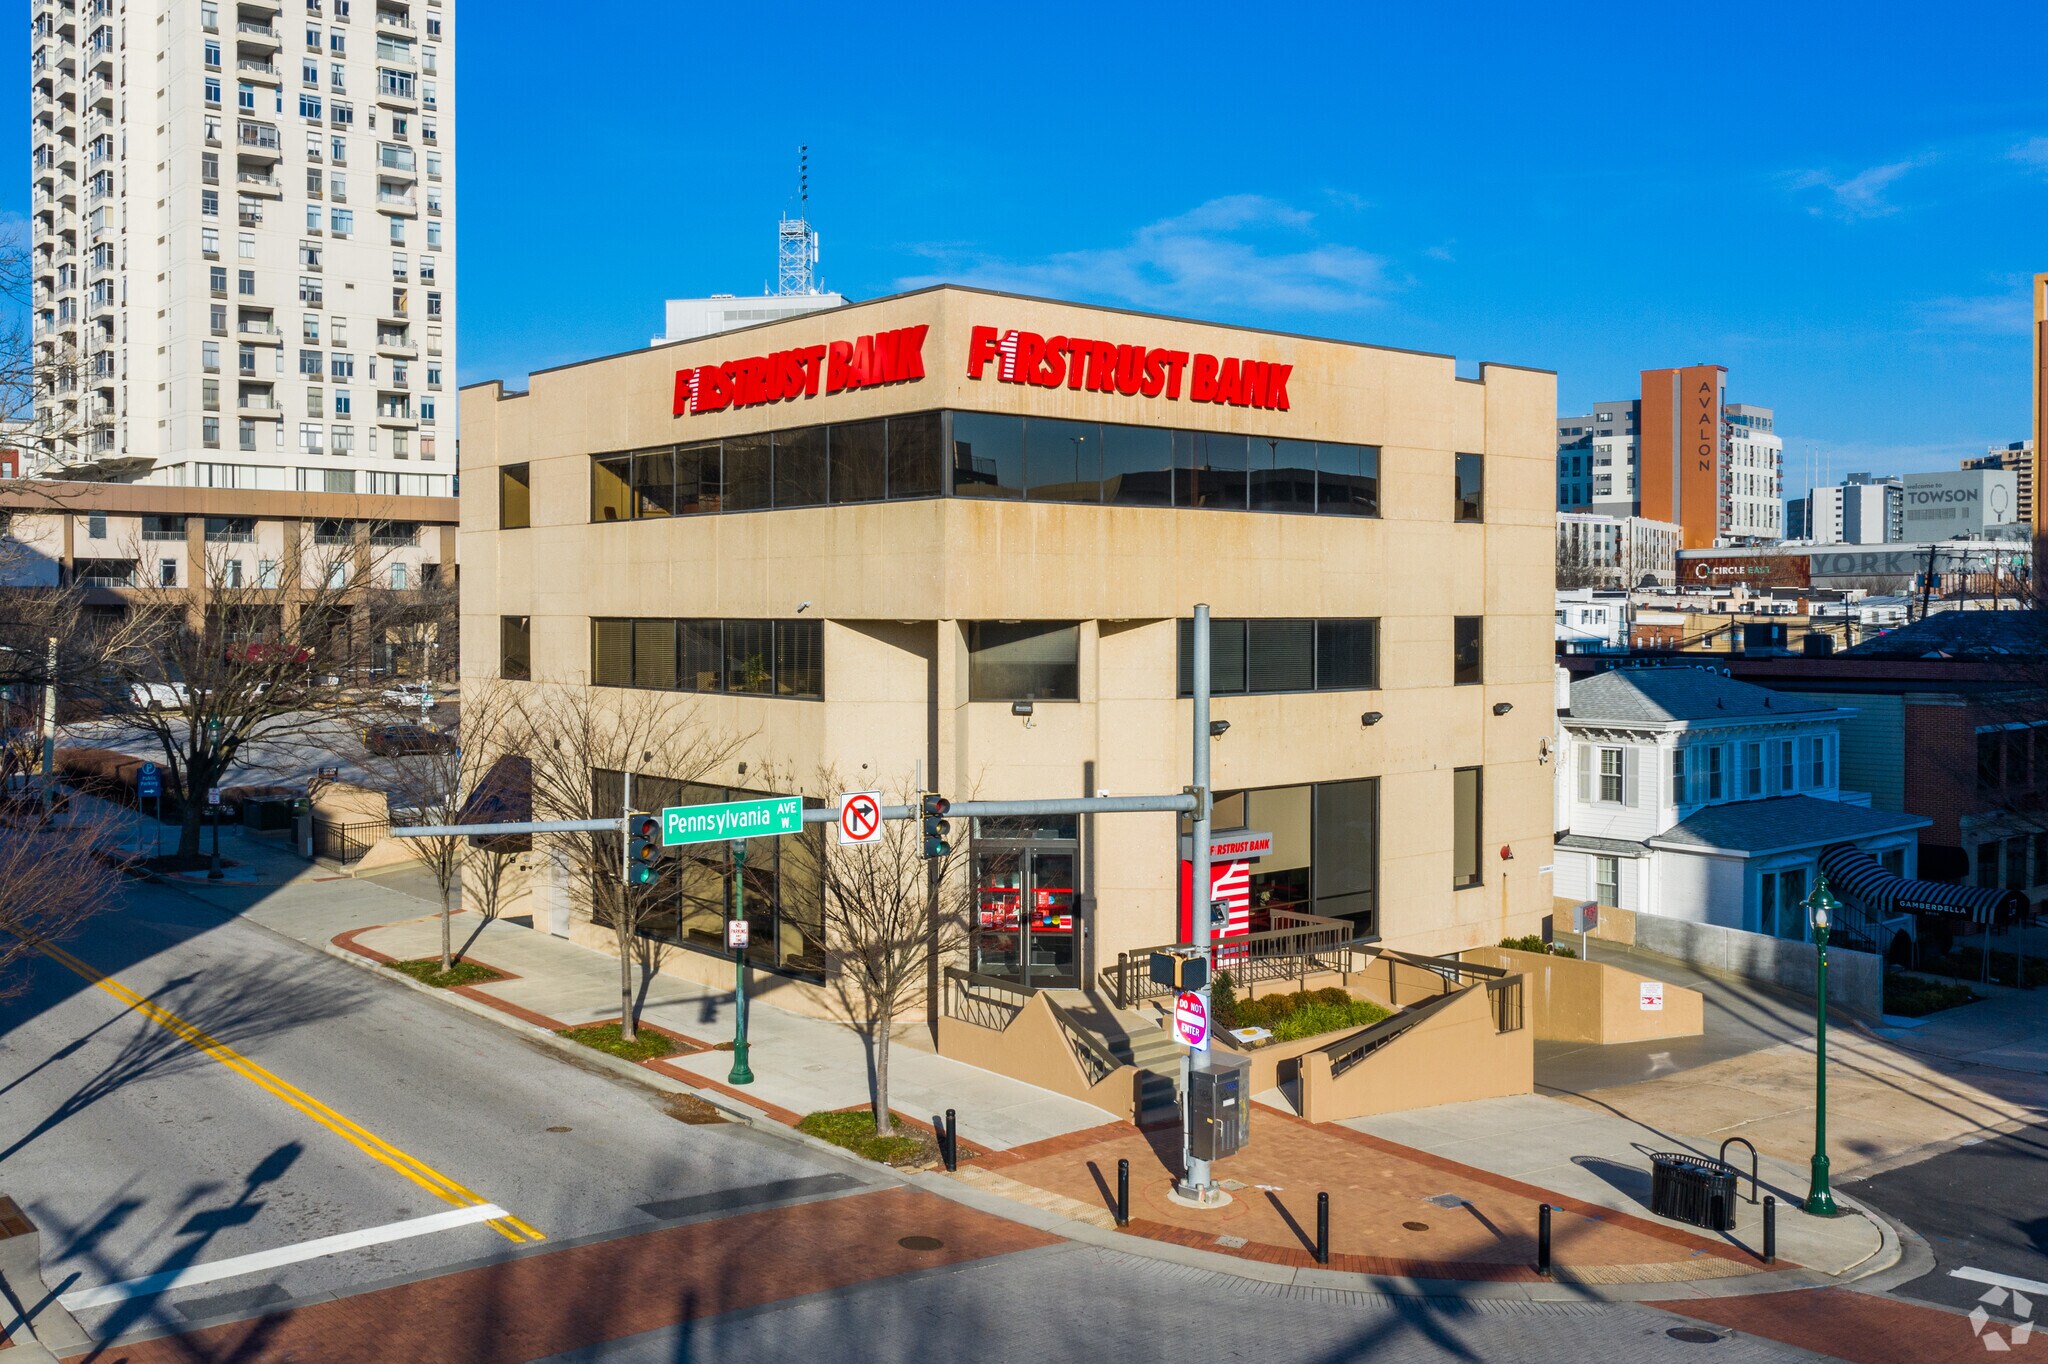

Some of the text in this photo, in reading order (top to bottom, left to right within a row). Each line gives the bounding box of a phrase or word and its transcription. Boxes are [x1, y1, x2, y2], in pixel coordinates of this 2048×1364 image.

[826, 324, 929, 396] BANK
[1190, 353, 1293, 410] BANK
[1698, 381, 1711, 472] AVALON
[1908, 488, 1978, 505] TOWSON
[1712, 566, 1745, 575] CIRCLE
[1812, 551, 1906, 574] YORK
[668, 801, 797, 834] Pennsylvania AVE
[781, 817, 793, 829] W.
[1249, 838, 1270, 851] BANK
[1899, 900, 1966, 914] GAMBERDELLA
[1179, 998, 1202, 1014] DO NOT
[1181, 1022, 1200, 1038] ENTER
